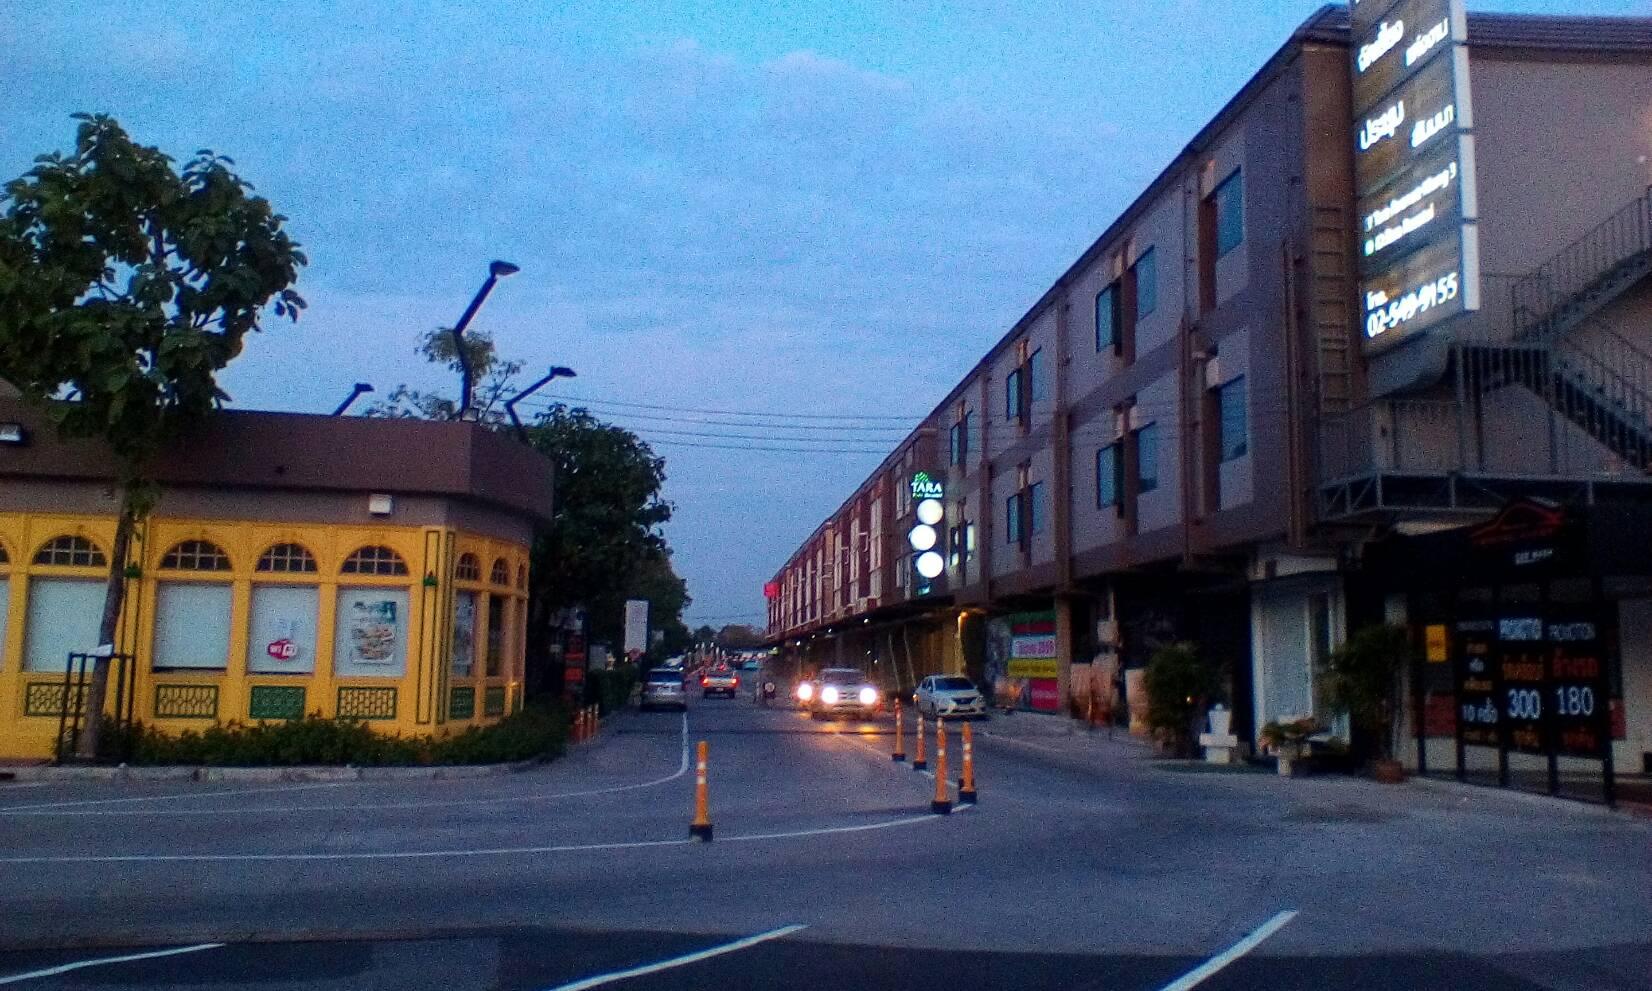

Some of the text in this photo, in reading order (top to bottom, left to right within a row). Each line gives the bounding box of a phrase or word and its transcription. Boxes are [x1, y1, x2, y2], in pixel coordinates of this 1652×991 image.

[911, 481, 942, 493] TARA
[1507, 688, 1542, 720] 300
[1556, 685, 1594, 717] 180
